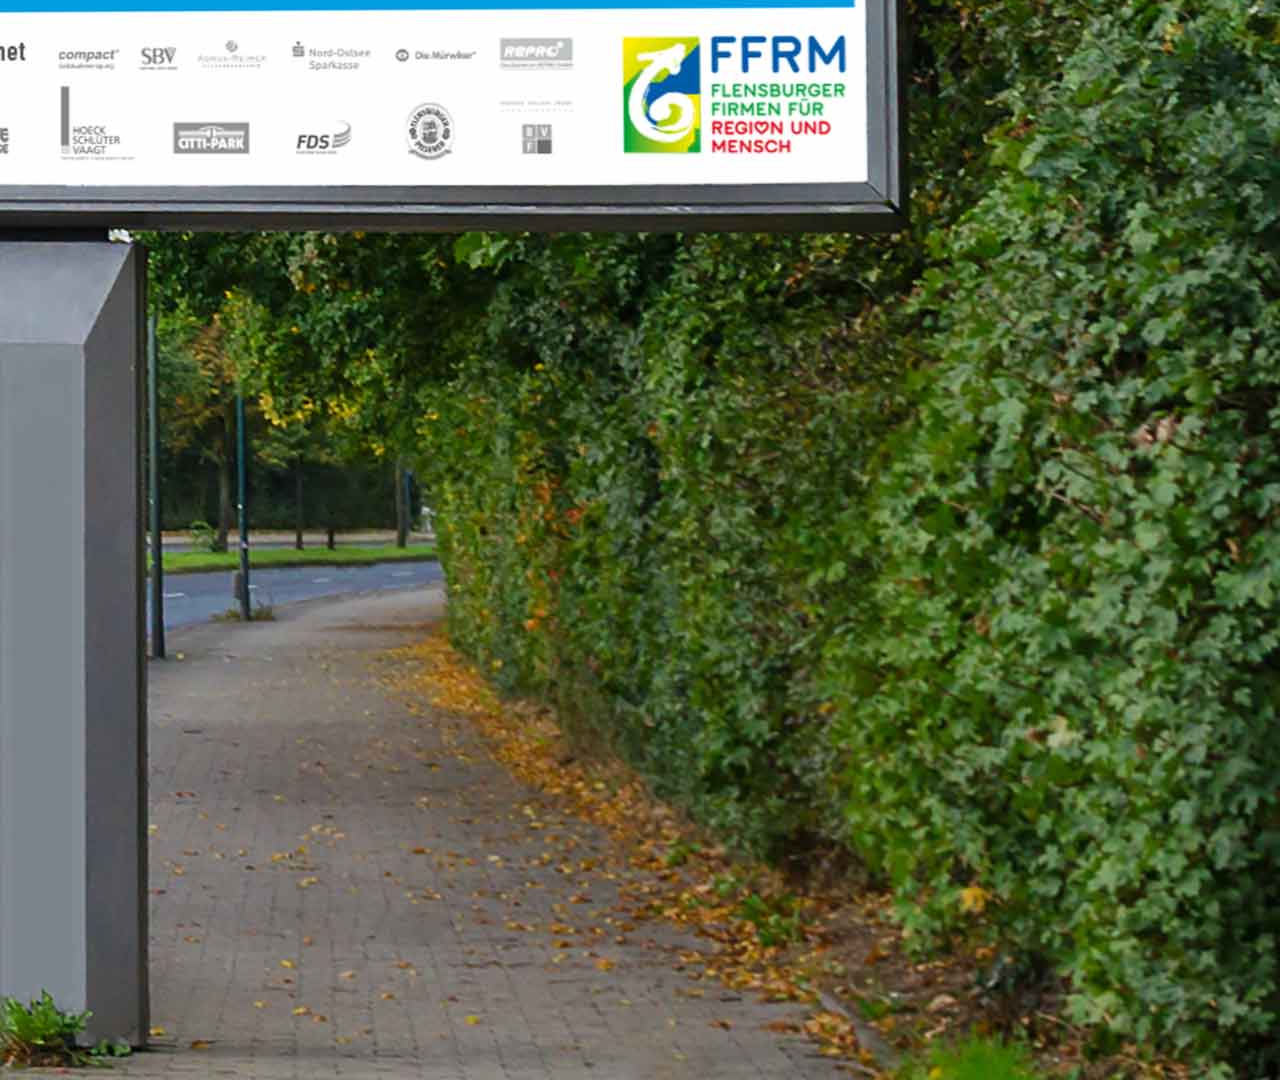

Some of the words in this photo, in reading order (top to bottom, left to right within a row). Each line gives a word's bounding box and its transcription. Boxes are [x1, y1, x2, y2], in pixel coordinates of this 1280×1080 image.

[58, 49, 116, 62] compact
[140, 47, 177, 65] SBV
[711, 35, 846, 73] FFRM
[308, 60, 360, 70] Sparkasse
[711, 83, 845, 98] FLENSBURGER
[711, 102, 783, 116] FIRMEN
[789, 98, 824, 116] FÜR
[791, 121, 831, 135] UND
[296, 134, 330, 149] FDS
[712, 139, 791, 153] MENSCH
